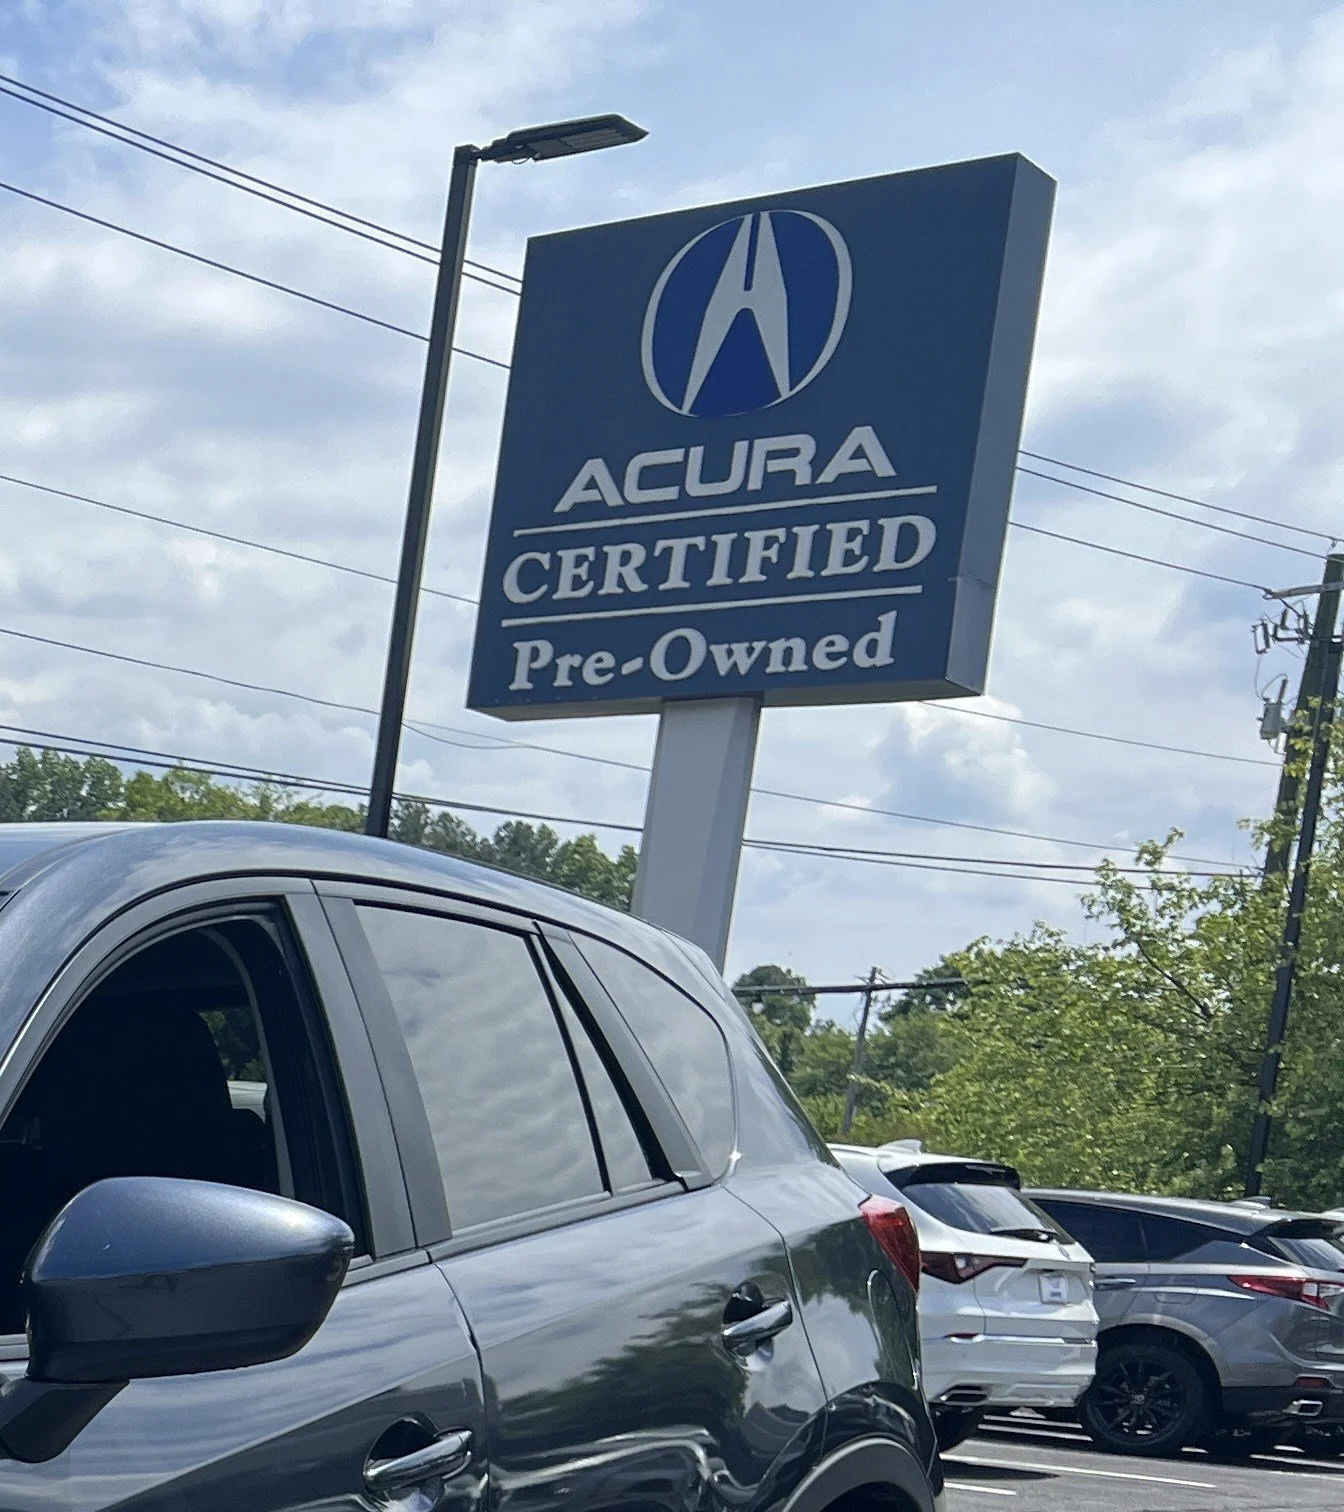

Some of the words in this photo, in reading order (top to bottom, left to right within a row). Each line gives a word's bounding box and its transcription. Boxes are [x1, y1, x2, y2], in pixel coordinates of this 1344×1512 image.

[553, 425, 897, 513] ACURA
[502, 514, 937, 603] CERTIFIED
[509, 610, 898, 691] Pre-Owned
